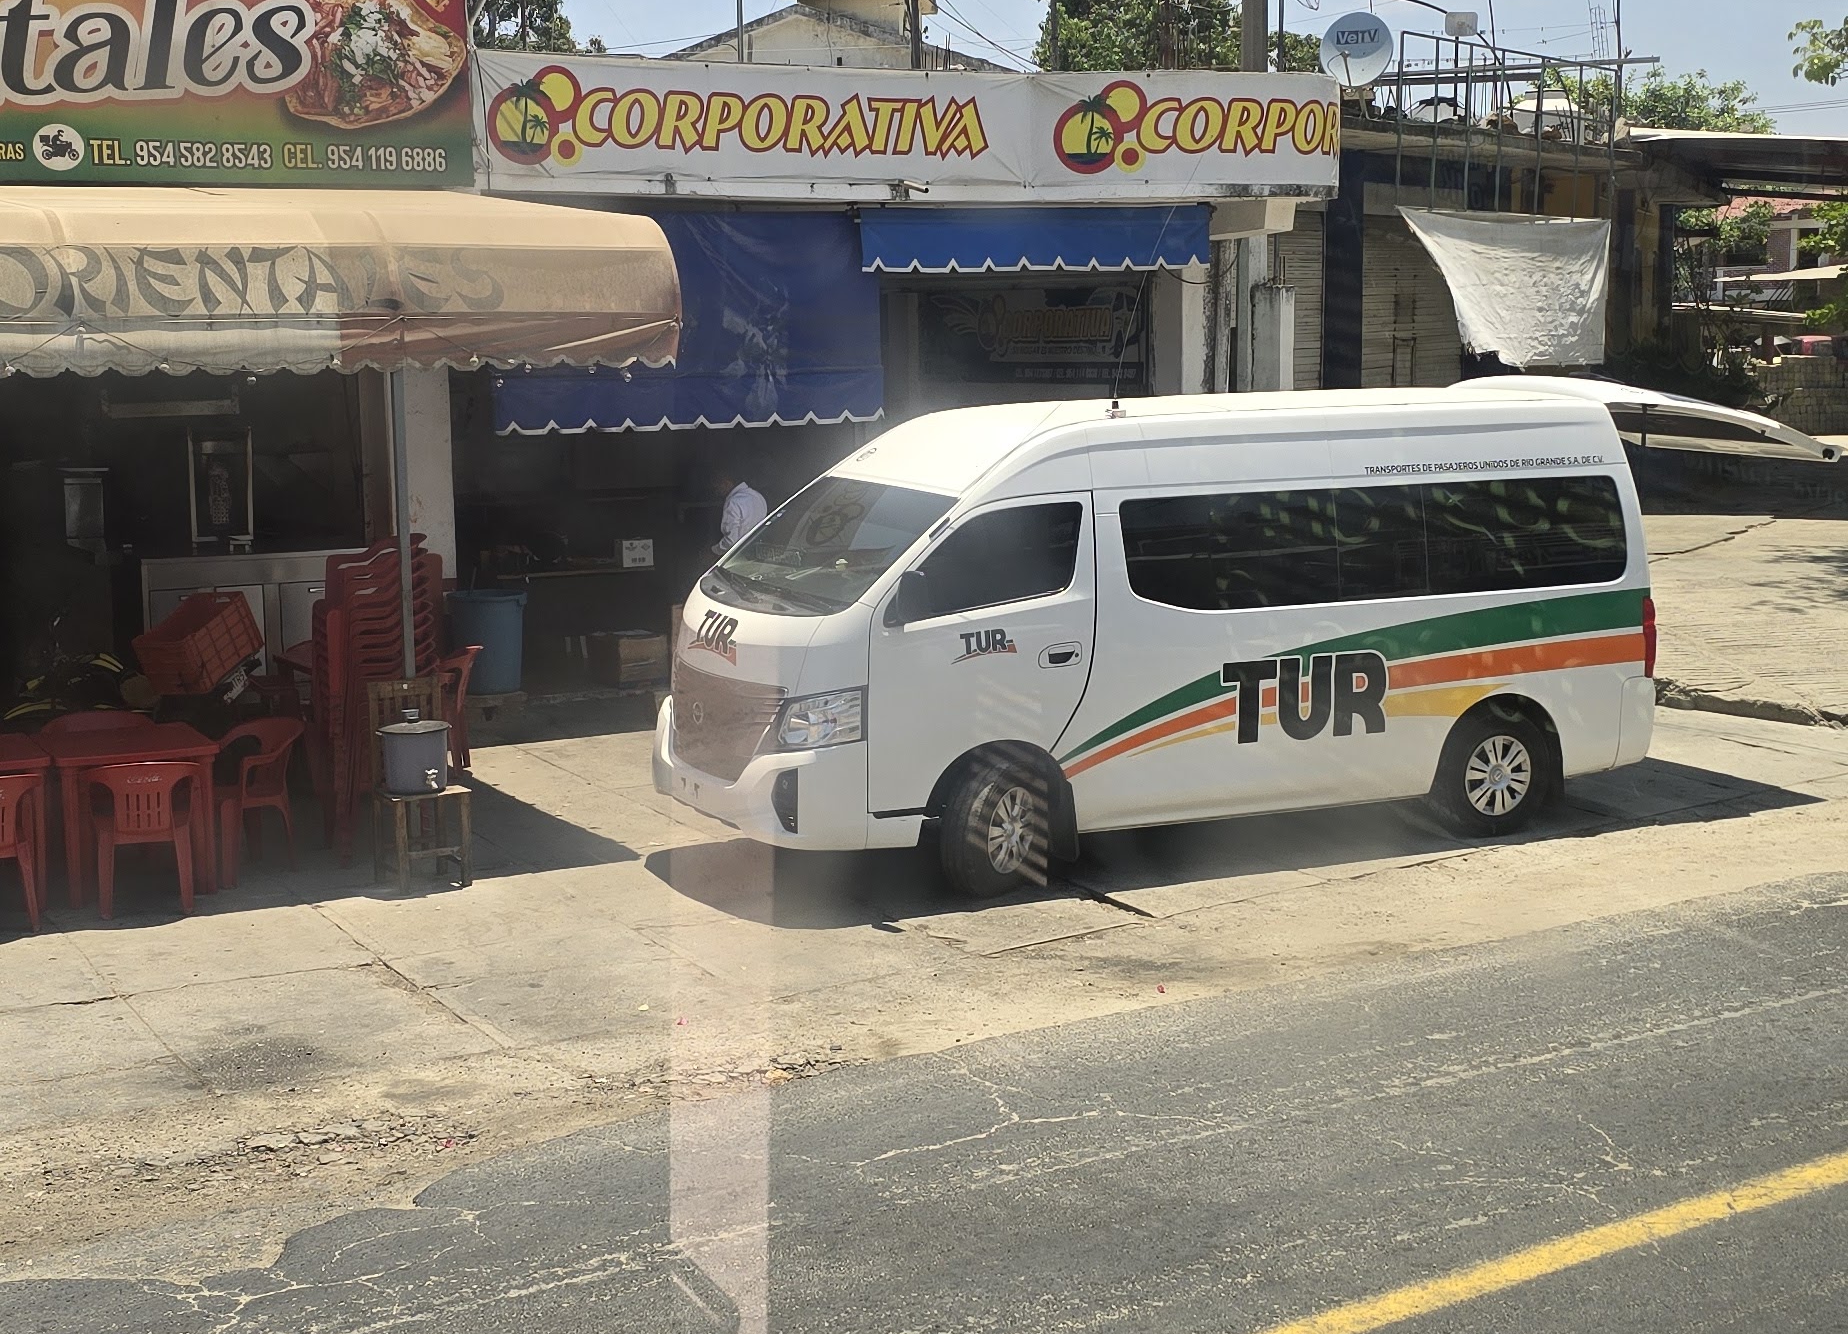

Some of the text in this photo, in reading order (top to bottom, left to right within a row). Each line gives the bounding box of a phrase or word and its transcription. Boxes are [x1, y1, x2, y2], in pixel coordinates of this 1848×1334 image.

[1337, 28, 1379, 45] VeTV
[574, 87, 989, 161] CORPORATIVA
[89, 139, 131, 165] TEL.
[135, 141, 175, 166] 954
[179, 142, 217, 167] 582
[222, 143, 272, 168] 8543
[282, 144, 323, 168] CEL.
[327, 145, 363, 170] 954
[368, 145, 397, 170] 119
[401, 146, 446, 172] 6886
[1364, 464, 1421, 475] TRANSPORTES
[1422, 464, 1433, 472] DE
[1434, 461, 1478, 471] PASAJEROS
[1479, 459, 1508, 469] UNIDOS
[1509, 459, 1520, 467] DE
[1535, 457, 1566, 466] GRANDE
[1581, 456, 1592, 464] DE
[1222, 652, 1388, 744] TUR
